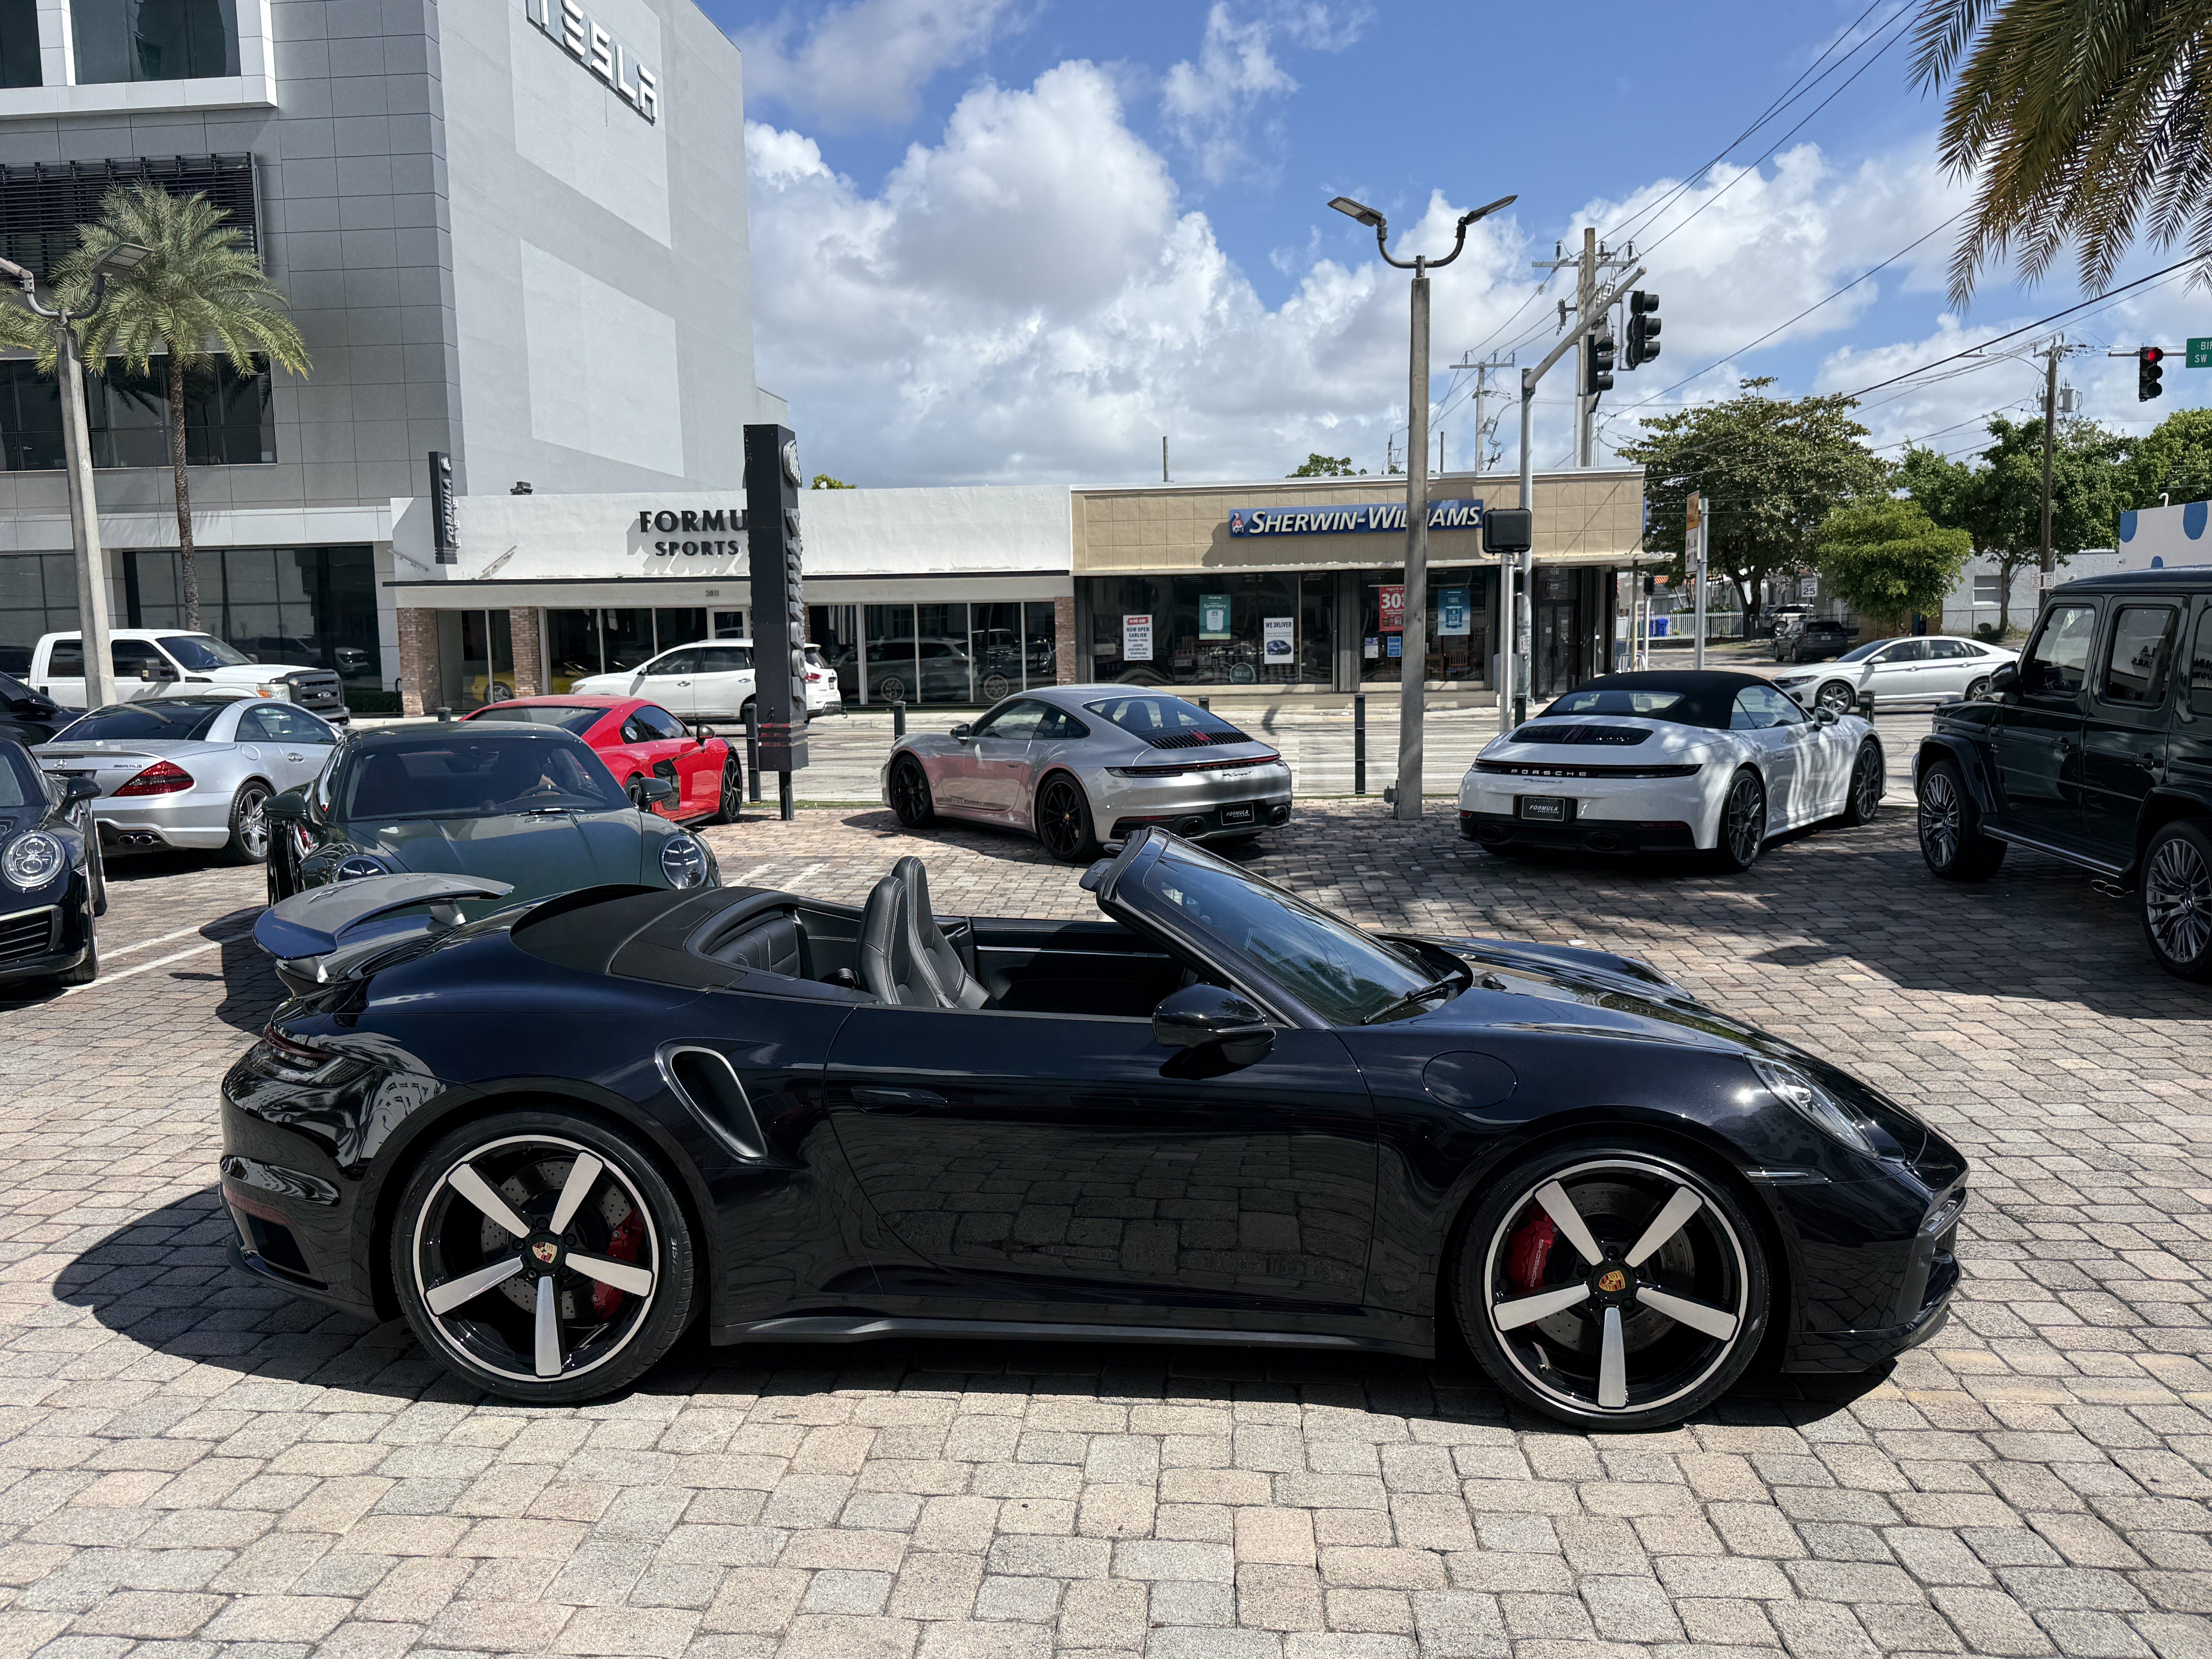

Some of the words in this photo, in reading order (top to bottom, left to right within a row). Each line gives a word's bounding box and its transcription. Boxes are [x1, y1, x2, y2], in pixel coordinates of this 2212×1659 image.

[2195, 354, 2207, 363] SW
[639, 510, 749, 533] FORMU
[1249, 506, 1480, 533] SHERWIN-WILIAMS
[655, 541, 739, 556] SPORTS
[1530, 1239, 1544, 1287] PORSCHE
